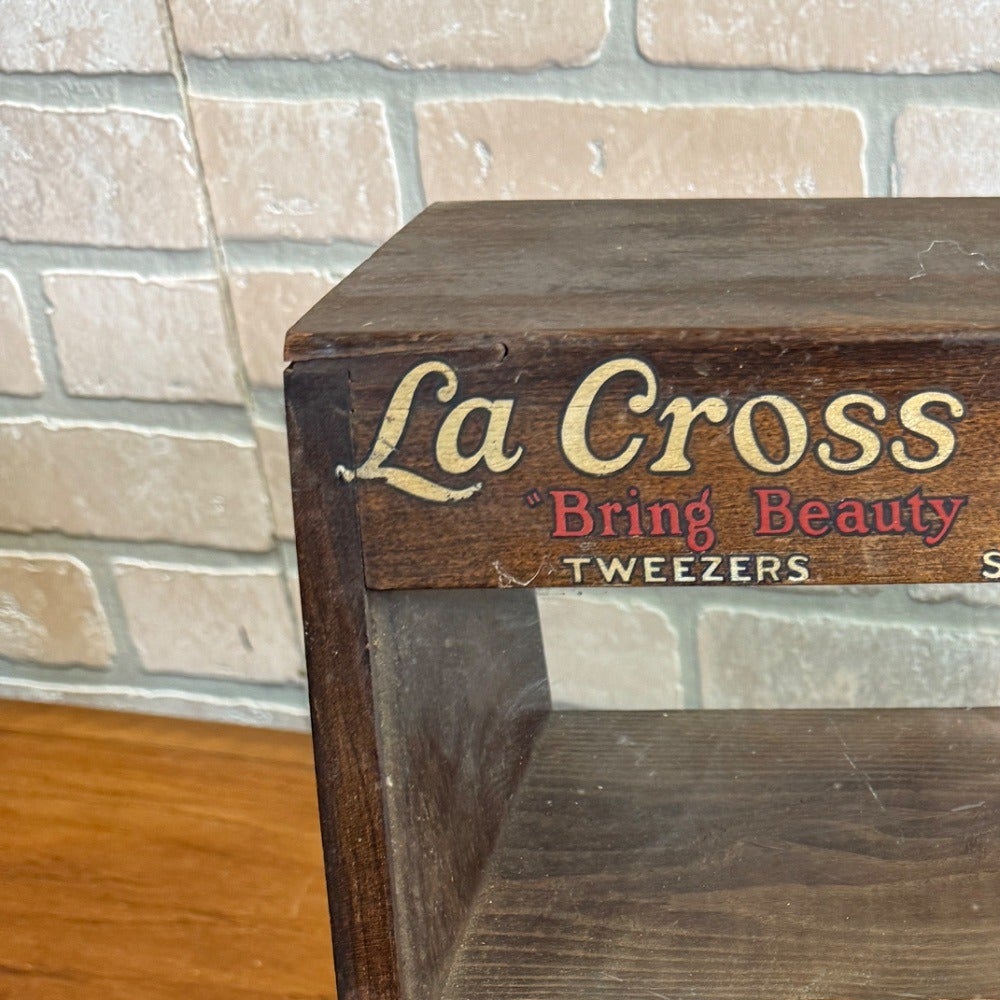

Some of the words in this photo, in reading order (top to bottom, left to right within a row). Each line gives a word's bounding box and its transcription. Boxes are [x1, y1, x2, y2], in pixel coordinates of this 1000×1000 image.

[335, 359, 524, 502] La
[560, 357, 966, 477] Cross
[754, 487, 968, 547] Beauty
[564, 555, 811, 584] TWEEZERS
